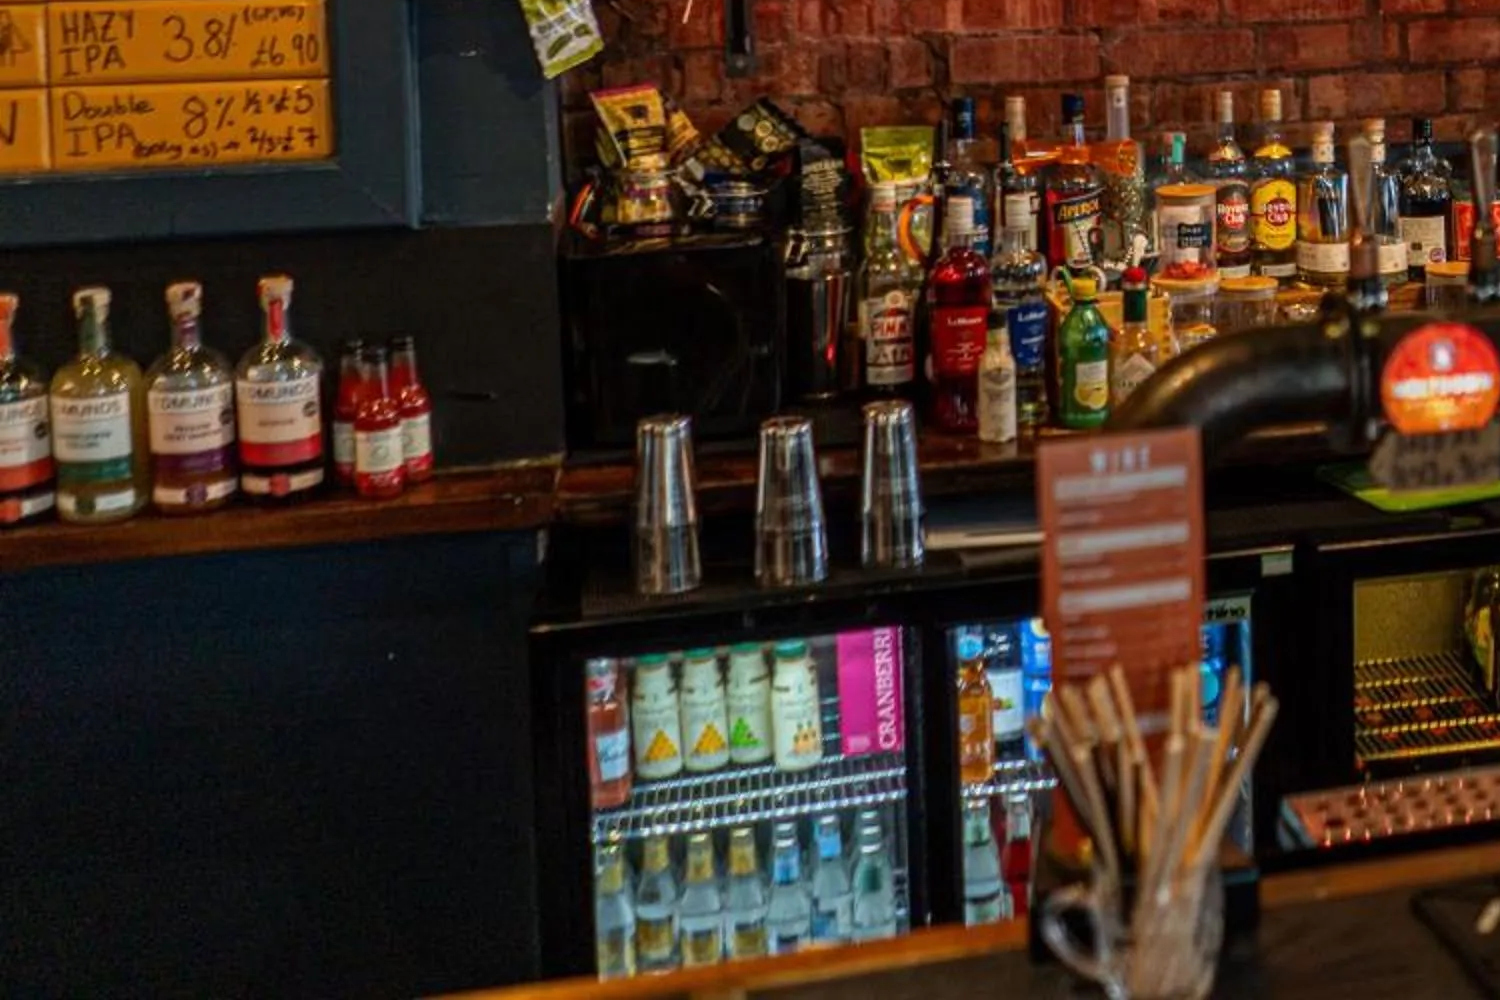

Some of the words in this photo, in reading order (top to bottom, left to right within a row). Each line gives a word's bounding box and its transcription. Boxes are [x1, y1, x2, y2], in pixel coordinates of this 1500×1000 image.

[60, 9, 135, 46] HAZY
[60, 43, 127, 77] IPA
[182, 94, 236, 140] 8%
[63, 121, 138, 158] IPA
